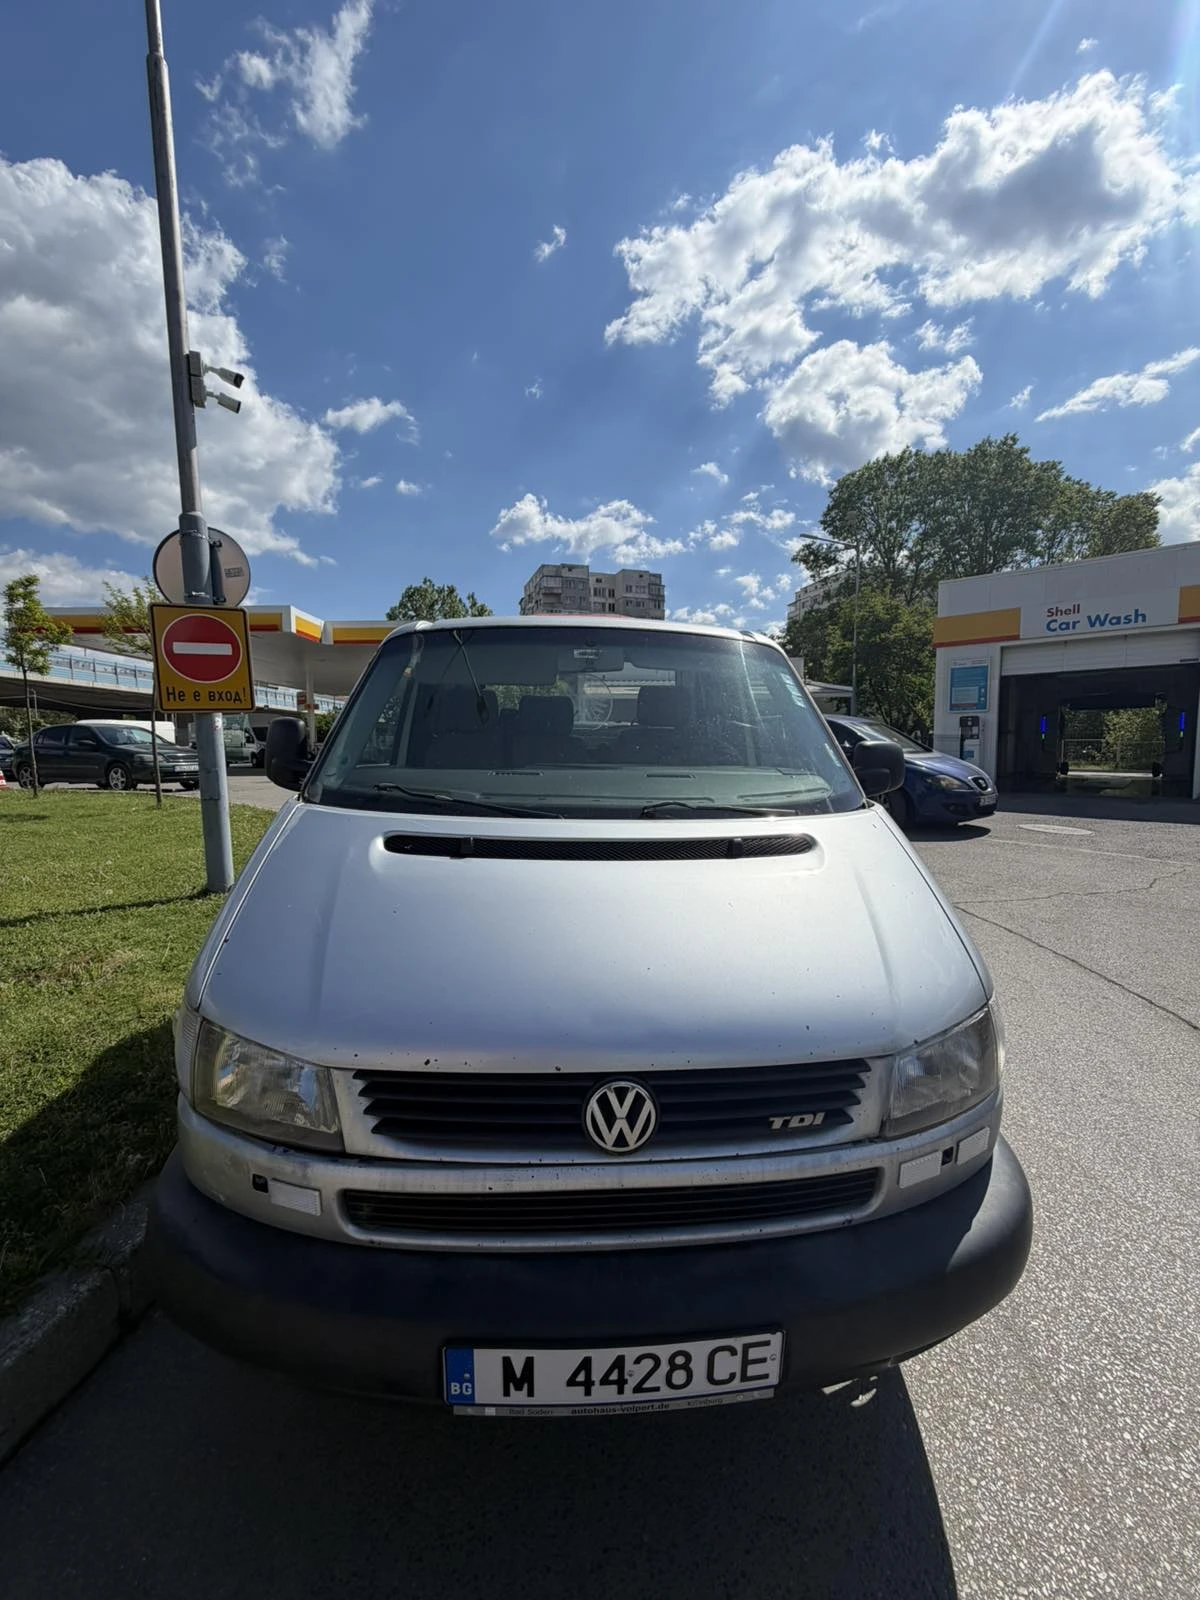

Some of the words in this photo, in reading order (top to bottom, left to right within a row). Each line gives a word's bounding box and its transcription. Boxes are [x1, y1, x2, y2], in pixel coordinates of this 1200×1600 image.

[1046, 603, 1081, 618] Shell
[1046, 618, 1080, 633] Car
[1087, 608, 1147, 629] Wash
[166, 686, 186, 702] Не
[193, 690, 201, 702] е
[208, 687, 247, 704] вход!
[586, 1081, 656, 1152] VW
[768, 1111, 826, 1130] TDI
[501, 1356, 535, 1398] M
[566, 1349, 693, 1397] 4428
[707, 1340, 772, 1386] CE
[450, 1381, 473, 1395] BG
